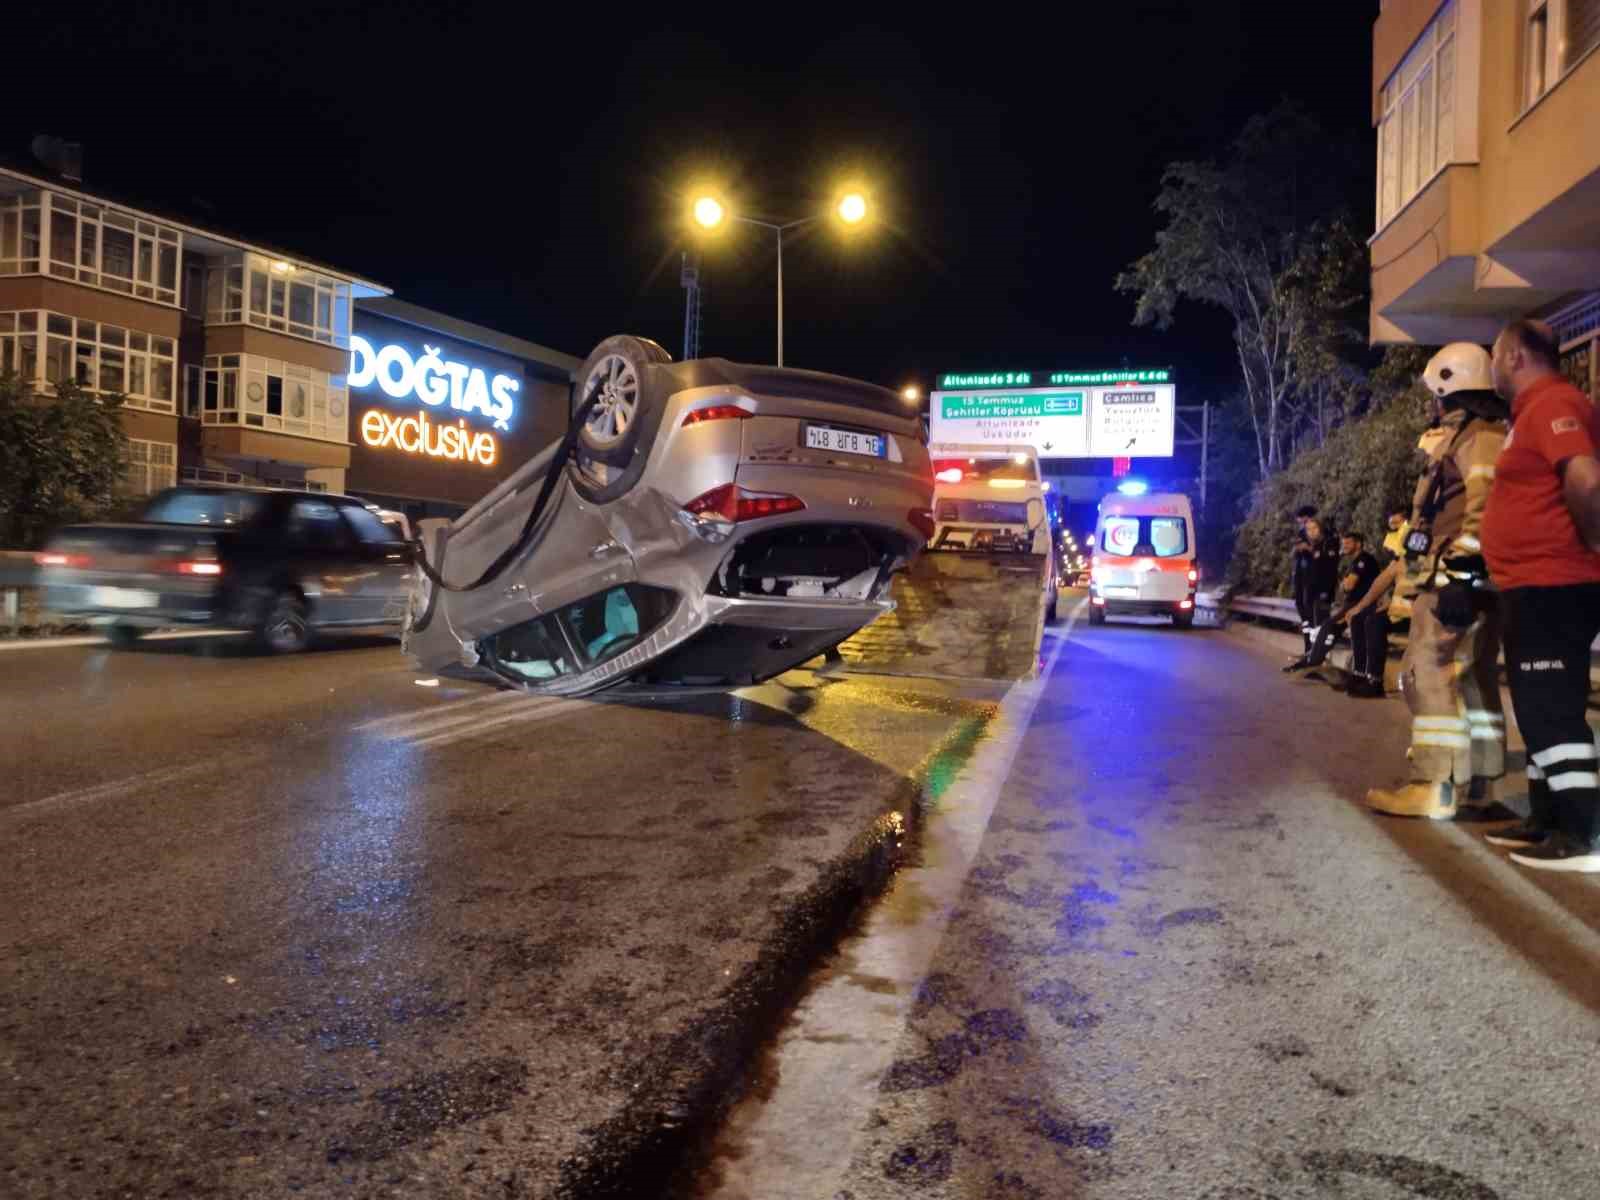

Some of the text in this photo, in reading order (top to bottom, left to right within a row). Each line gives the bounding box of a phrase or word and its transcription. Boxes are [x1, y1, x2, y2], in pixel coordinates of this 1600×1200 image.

[347, 336, 518, 430] DOĞTAŞ
[944, 375, 1003, 385] Altunizade
[963, 396, 1024, 405] 15 Temmuz
[976, 419, 1040, 428] Altunizade
[361, 410, 495, 465] exclusive
[810, 428, 879, 453] 34 BJR 814
